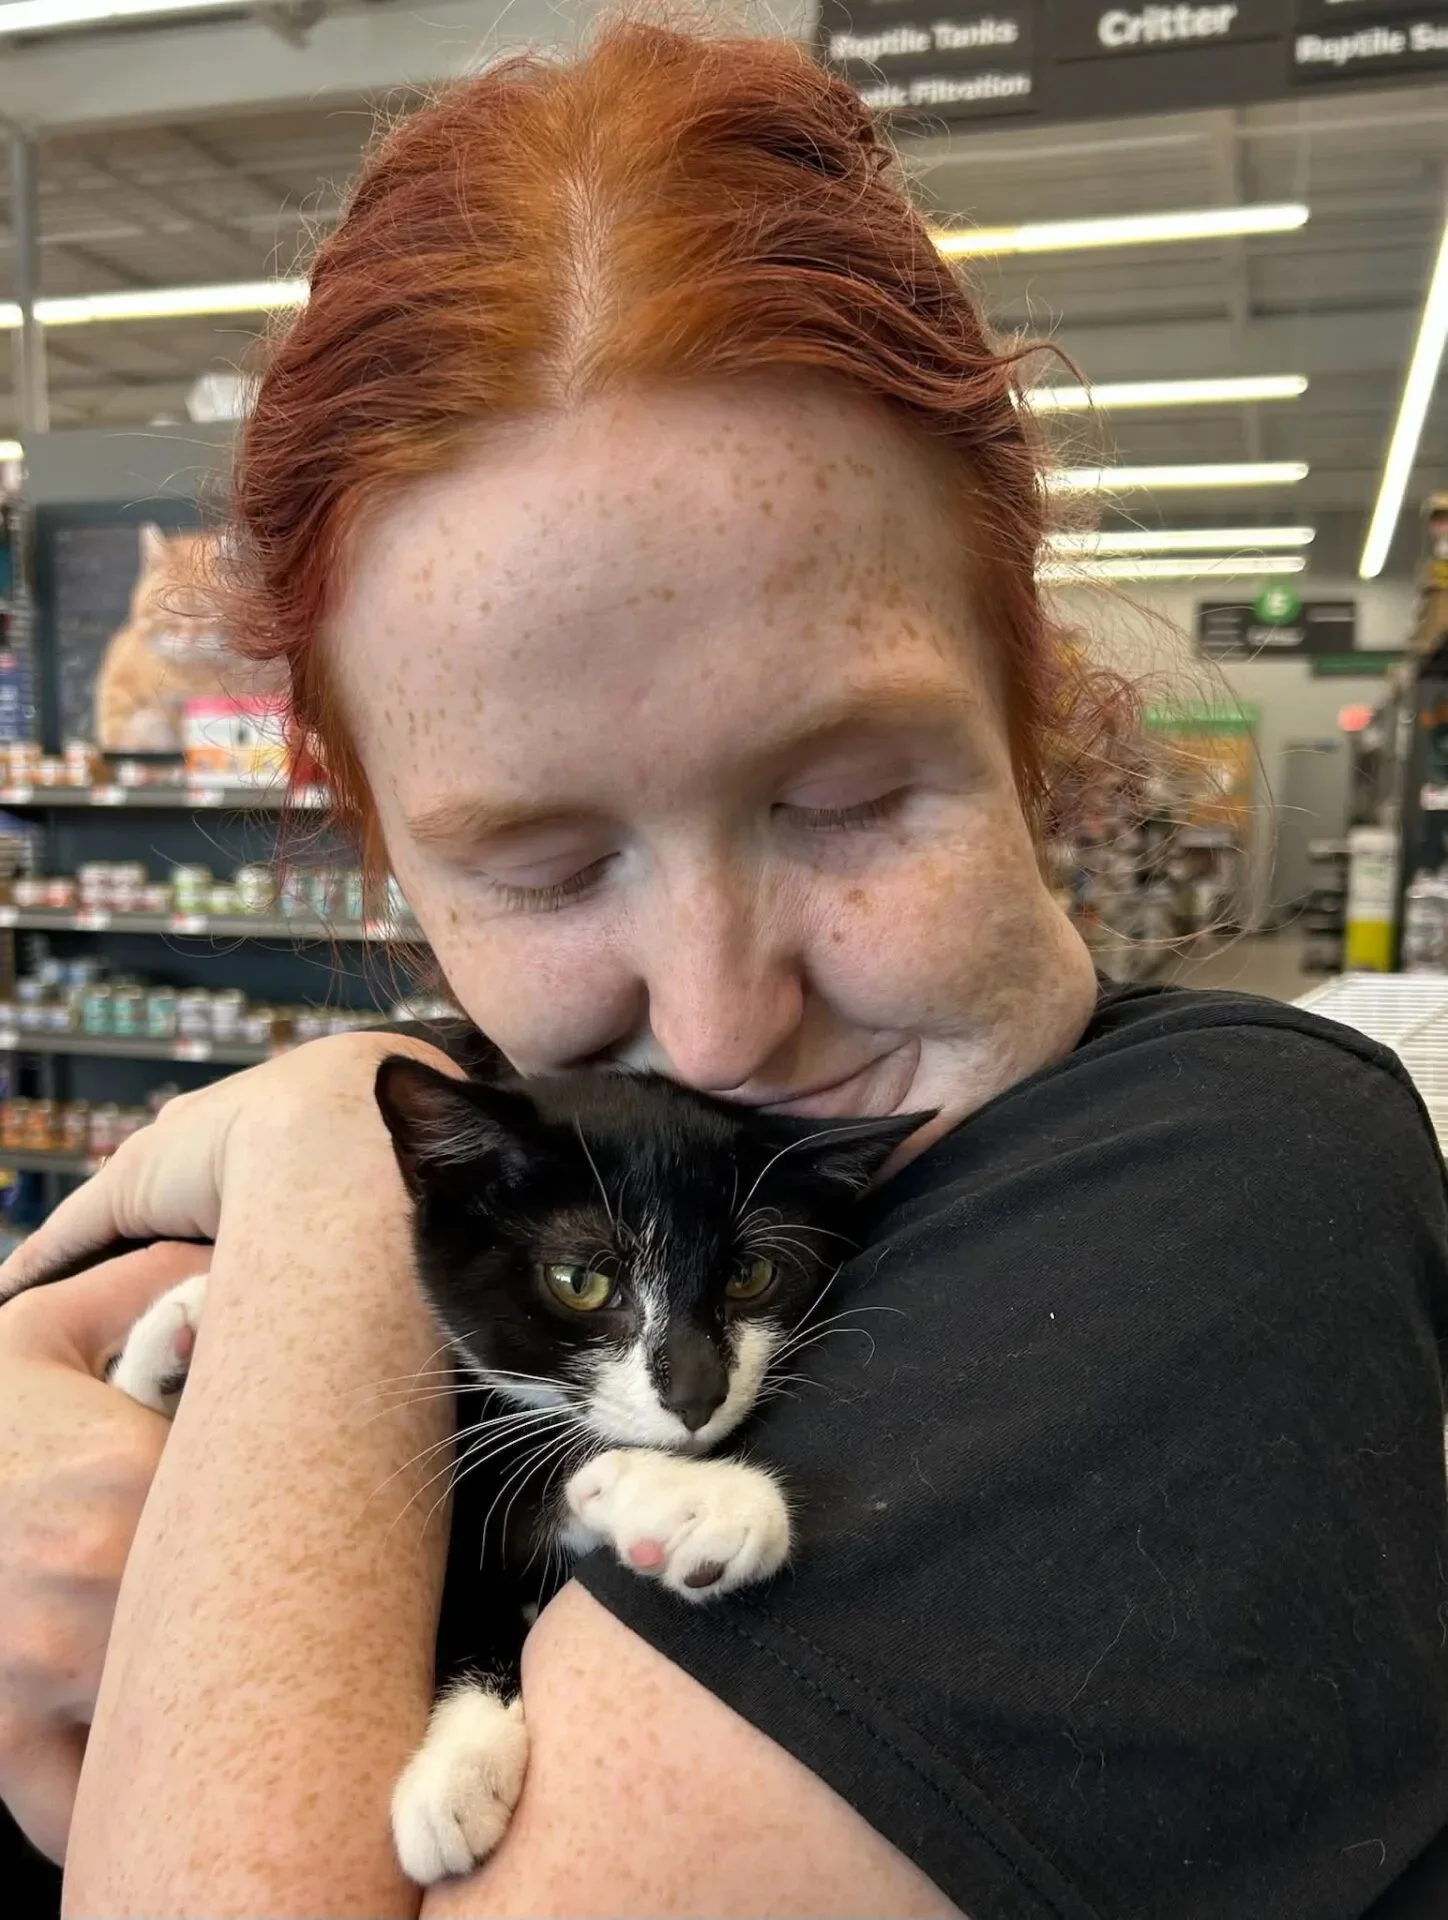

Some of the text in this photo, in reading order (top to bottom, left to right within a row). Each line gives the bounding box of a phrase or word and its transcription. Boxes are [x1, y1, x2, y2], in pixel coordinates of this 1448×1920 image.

[931, 18, 1019, 48] Tanks
[1098, 4, 1238, 47] Critter
[1296, 26, 1406, 66] Reptile
[908, 74, 1031, 105] Filtration
